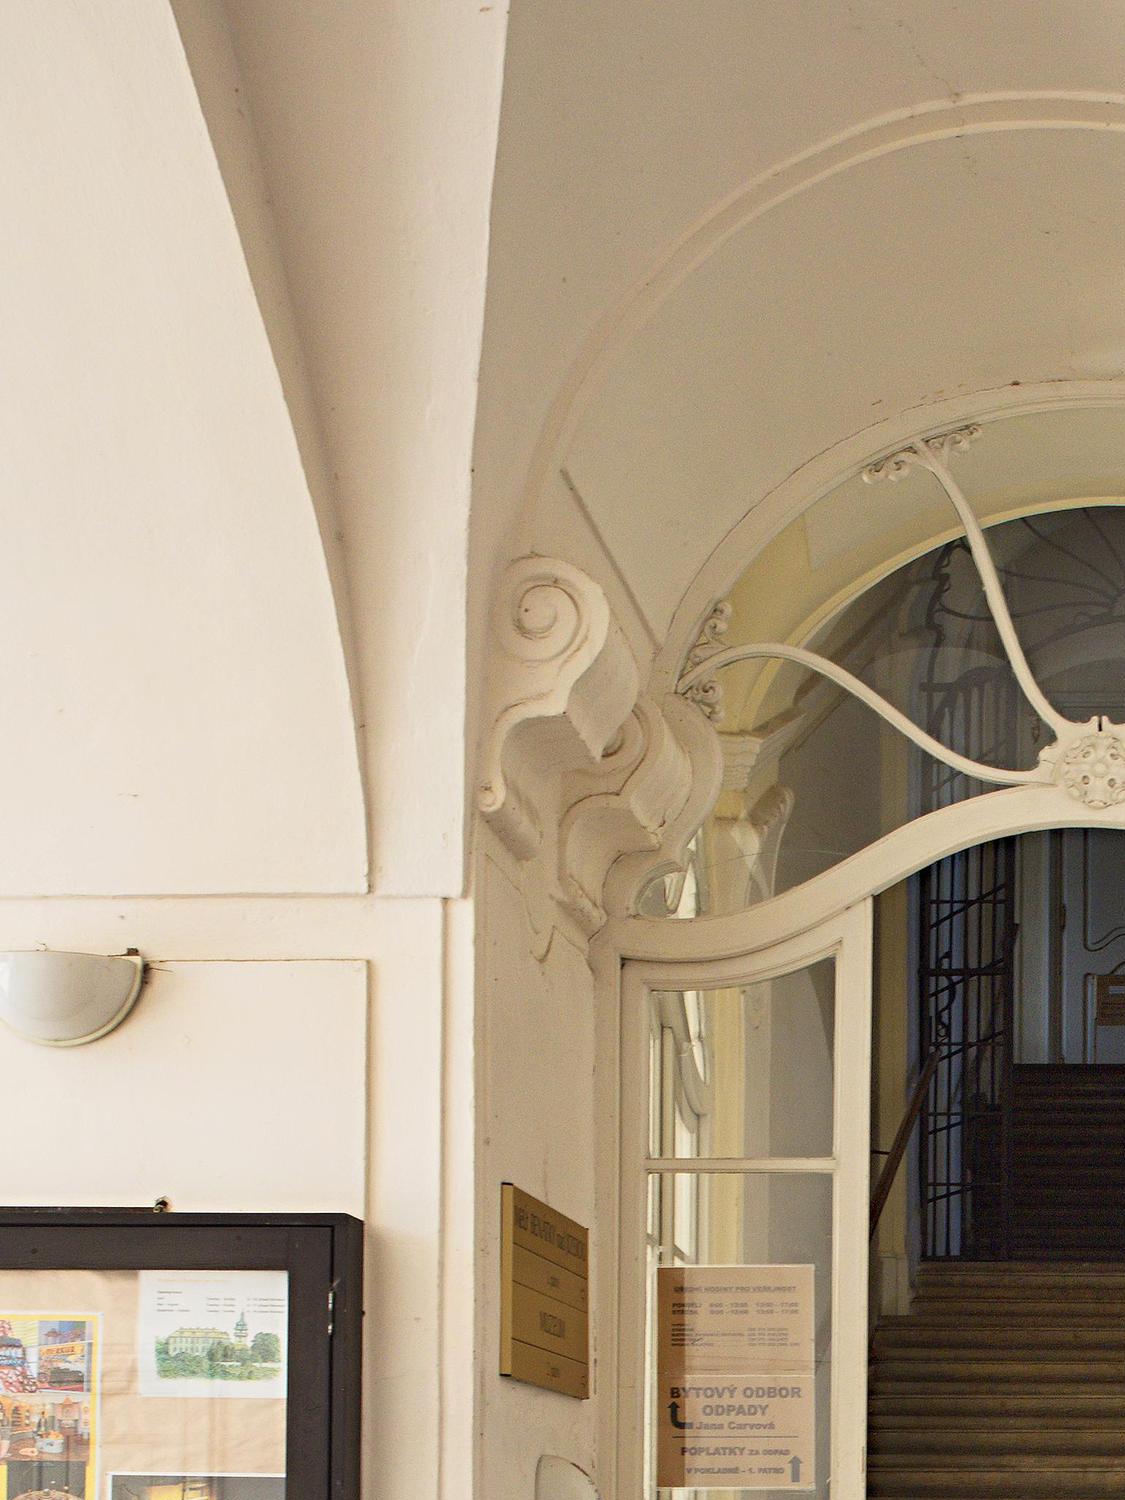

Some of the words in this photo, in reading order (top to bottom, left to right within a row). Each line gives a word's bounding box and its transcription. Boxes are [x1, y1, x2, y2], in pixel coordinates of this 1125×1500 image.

[669, 1384, 737, 1399] BYTOVÝ
[742, 1387, 803, 1399] ODBOR
[702, 1404, 769, 1417] ODPADY
[680, 1446, 746, 1456] POPLATKY
